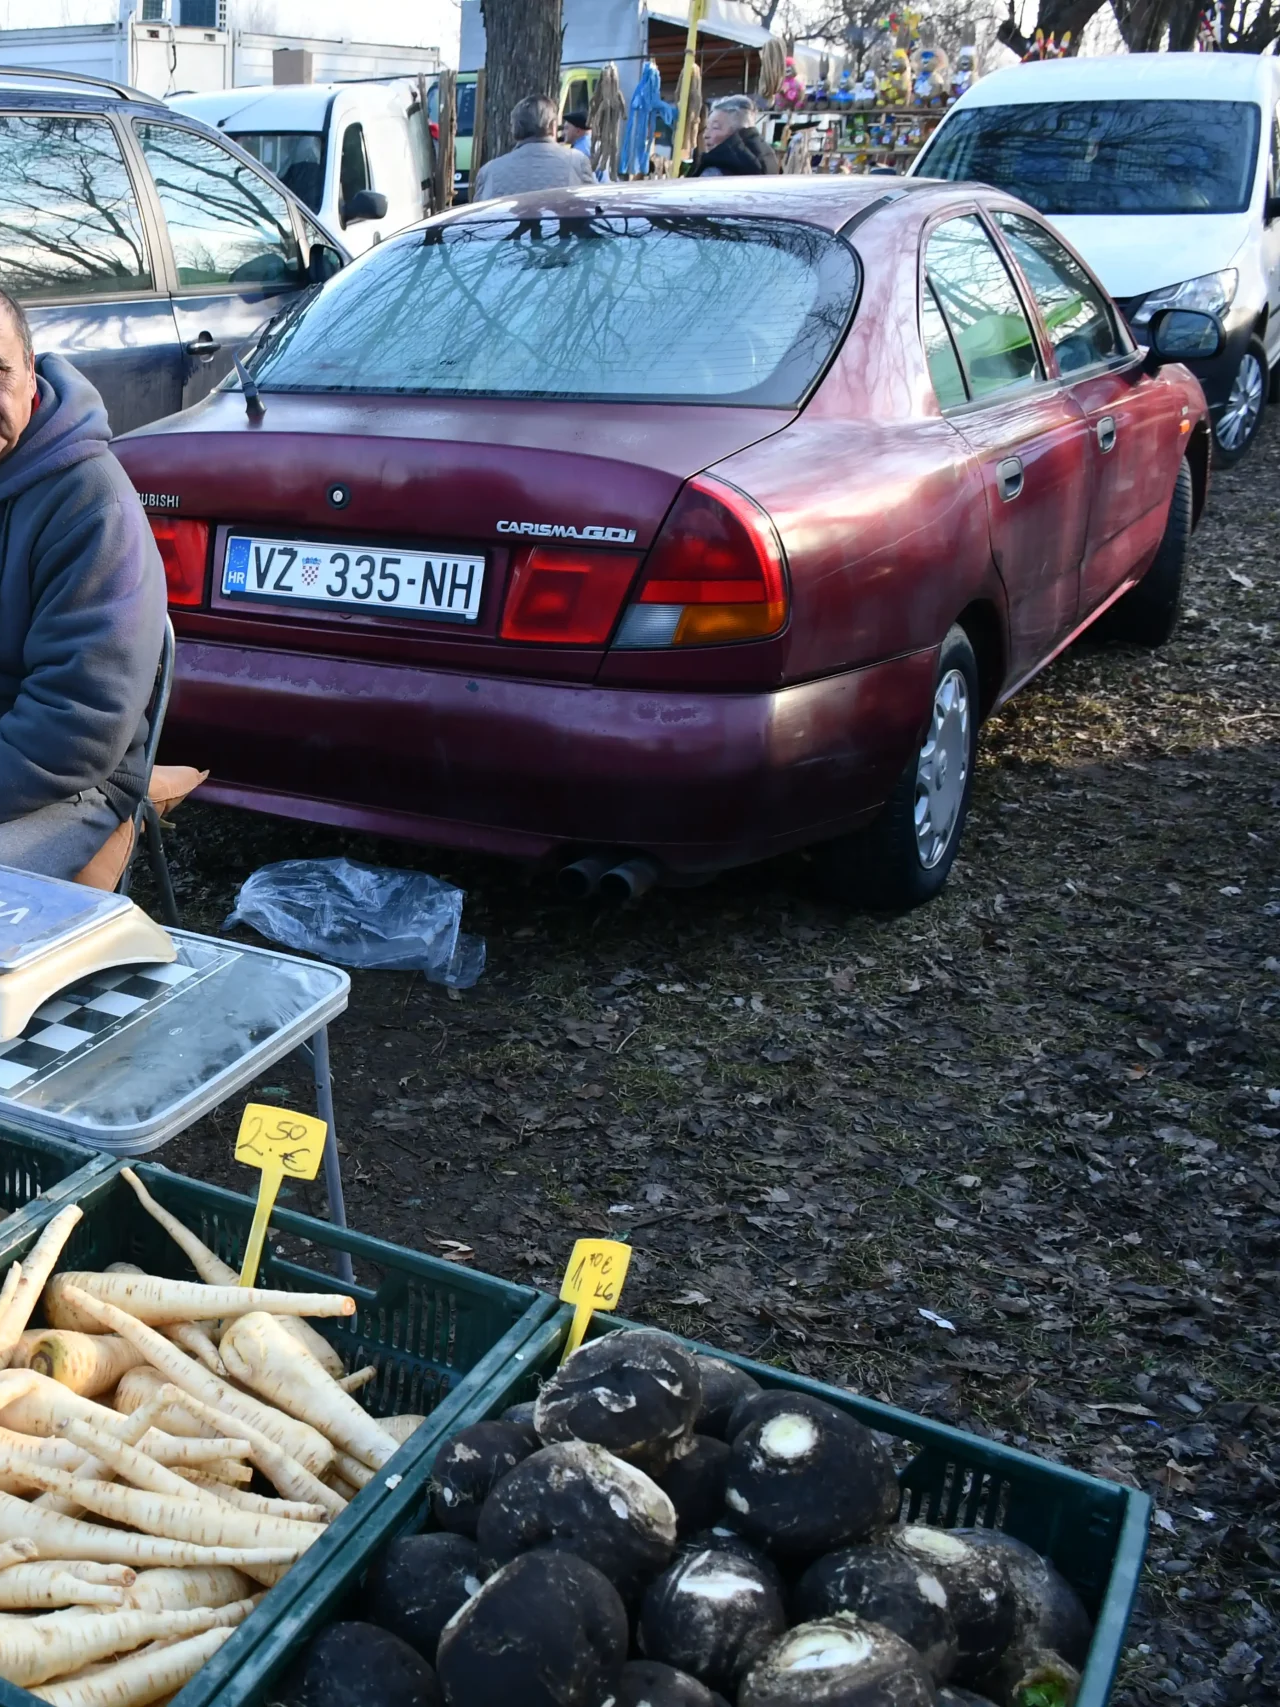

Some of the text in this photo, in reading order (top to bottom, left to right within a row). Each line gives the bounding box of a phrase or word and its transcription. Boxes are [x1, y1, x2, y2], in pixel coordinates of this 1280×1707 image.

[496, 520, 578, 538] CARISMA
[227, 570, 246, 585] HR
[254, 546, 476, 609] VŽ 335-NH
[278, 1148, 311, 1173] €
